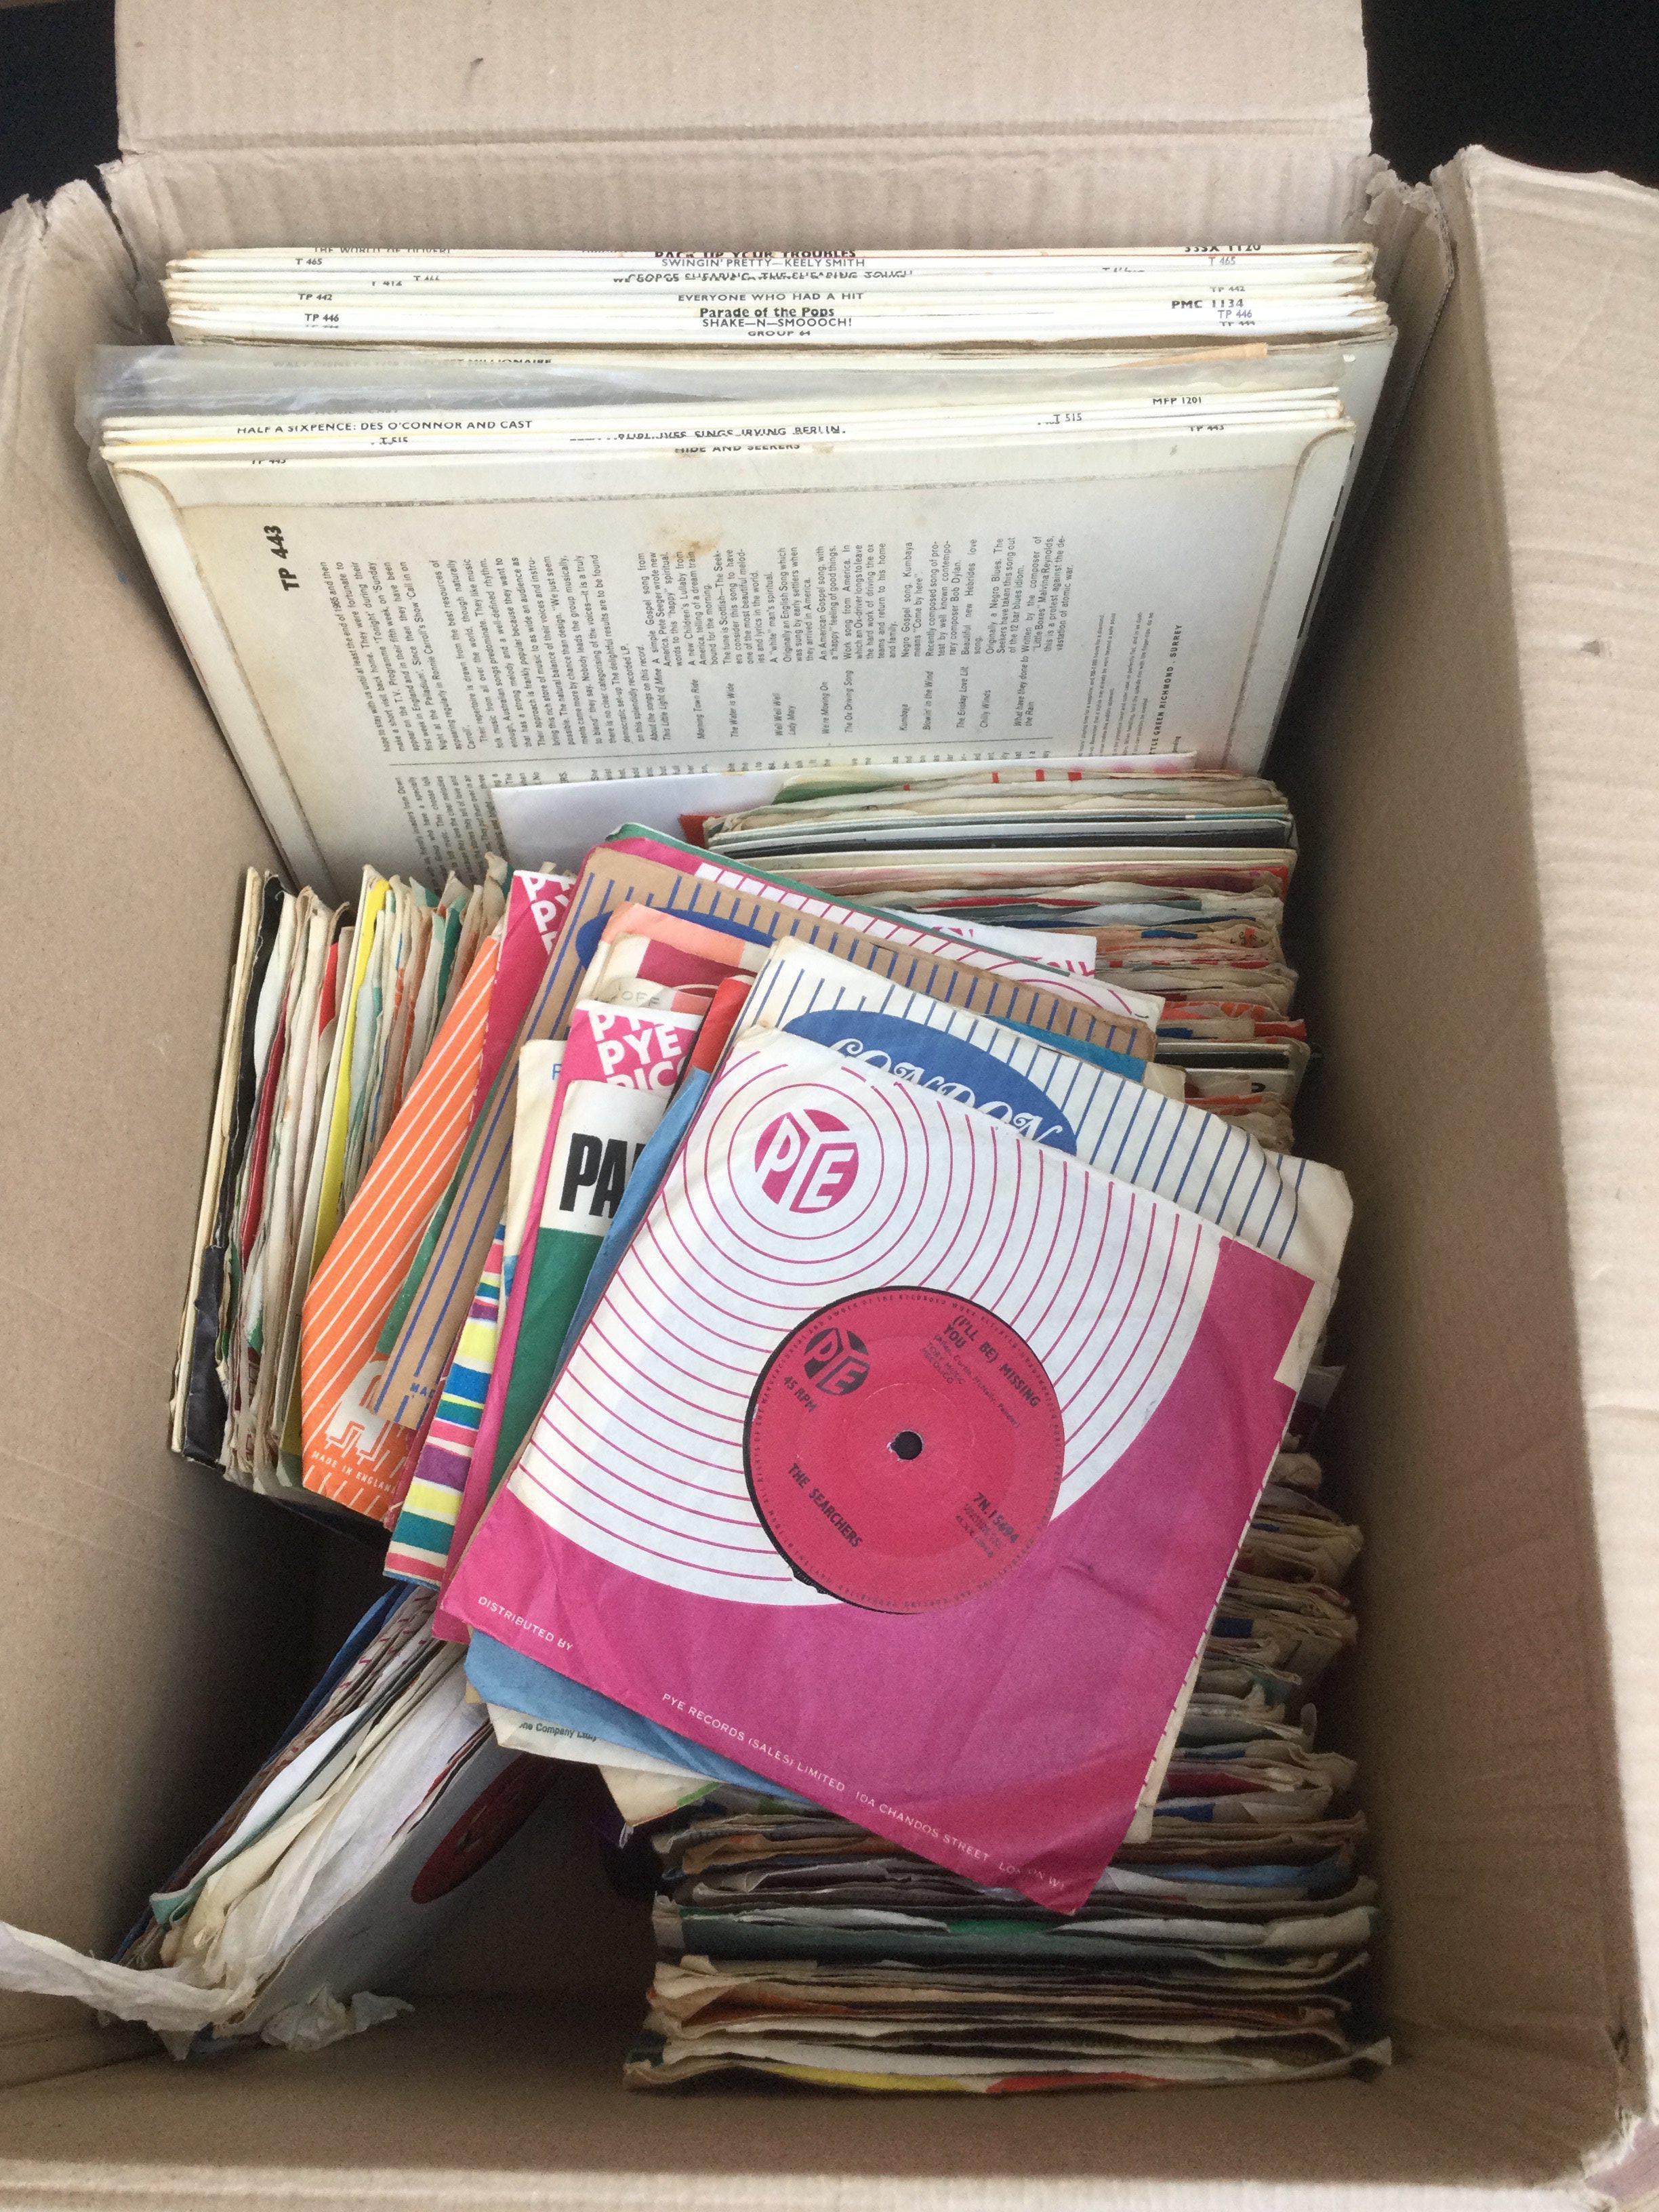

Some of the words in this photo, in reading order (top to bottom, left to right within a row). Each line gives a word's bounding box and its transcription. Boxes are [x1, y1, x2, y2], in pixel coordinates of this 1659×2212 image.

[661, 259, 723, 267] SWINGIN'
[825, 259, 865, 267] SMITH
[1220, 256, 1235, 265] 465
[699, 308, 750, 318] Parade
[754, 308, 768, 318] of
[774, 308, 796, 318] the
[802, 307, 834, 318] Pops
[1172, 300, 1203, 308] PMC
[1212, 299, 1244, 308] 1134
[304, 313, 319, 322] TP
[323, 314, 340, 322] 446
[1217, 310, 1232, 319] TP
[1236, 310, 1252, 318] 446
[1182, 396, 1202, 405] 1201
[287, 423, 356, 433] SIXPENCE:
[361, 422, 383, 430] DES
[388, 422, 462, 430] O'CONNOR
[466, 421, 496, 429] AND
[500, 420, 533, 429] CAST
[1065, 413, 1082, 422] 515
[262, 525, 289, 559] 443
[841, 545, 851, 553] In
[495, 558, 504, 567] to
[637, 553, 647, 571] from
[902, 542, 913, 578] Kumbaya
[277, 568, 300, 592] TP
[497, 568, 508, 587] want
[651, 570, 661, 591] wrote
[842, 558, 851, 592] America.
[641, 576, 650, 595] song
[950, 587, 960, 602] Bob
[1038, 574, 1049, 603] Malvina
[502, 589, 512, 605] they
[655, 592, 665, 617] Seeger
[842, 598, 851, 615] from
[506, 607, 520, 637] because
[643, 600, 655, 626] Gospel
[901, 607, 912, 633] Gospel
[950, 605, 959, 640] composer
[657, 619, 667, 636] Pete
[669, 621, 678, 634] this
[844, 619, 853, 637] song
[648, 630, 659, 653] simple
[671, 636, 680, 644] to
[900, 637, 911, 658] Negro
[949, 642, 958, 656] rary
[514, 639, 528, 665] popular
[672, 646, 682, 667] words
[722, 651, 731, 665] The
[842, 642, 851, 661] Work
[520, 668, 532, 690] frankly
[690, 679, 699, 694] Ride
[843, 670, 853, 687] Song
[1153, 712, 1164, 736] GREEN
[1159, 667, 1173, 709] RICHMOND
[1169, 626, 1181, 658] SURREY
[693, 695, 702, 712] Town
[843, 688, 853, 711] Driving
[528, 699, 542, 729] approach
[844, 712, 853, 722] Ox
[695, 714, 705, 740] Morning
[844, 722, 853, 733] The
[536, 731, 546, 747] Their
[597, 1024, 682, 1077] PYE
[754, 1109, 859, 1214] PYE
[943, 1324, 966, 1349] YOU
[804, 1326, 870, 1397] PYE
[979, 1340, 998, 1364] BE)
[1000, 1364, 1041, 1408] MISSING
[784, 1376, 798, 1391] 45
[794, 1387, 817, 1413] RPM
[311, 1450, 337, 1469] MADE
[342, 1465, 354, 1476] IN
[788, 1462, 811, 1490] THE
[808, 1488, 863, 1548] SEARCHERS
[477, 1595, 554, 1643] DISTRIBUTED
[557, 1637, 574, 1652] BY
[535, 1723, 575, 1738] Company
[661, 1692, 684, 1711] PYE
[687, 1705, 746, 1742] RECORDS
[747, 1736, 795, 1767] (SALES)
[796, 1761, 846, 1794] LIMITED
[878, 1803, 940, 1839] CHANDOS
[942, 1832, 991, 1862] STREET
